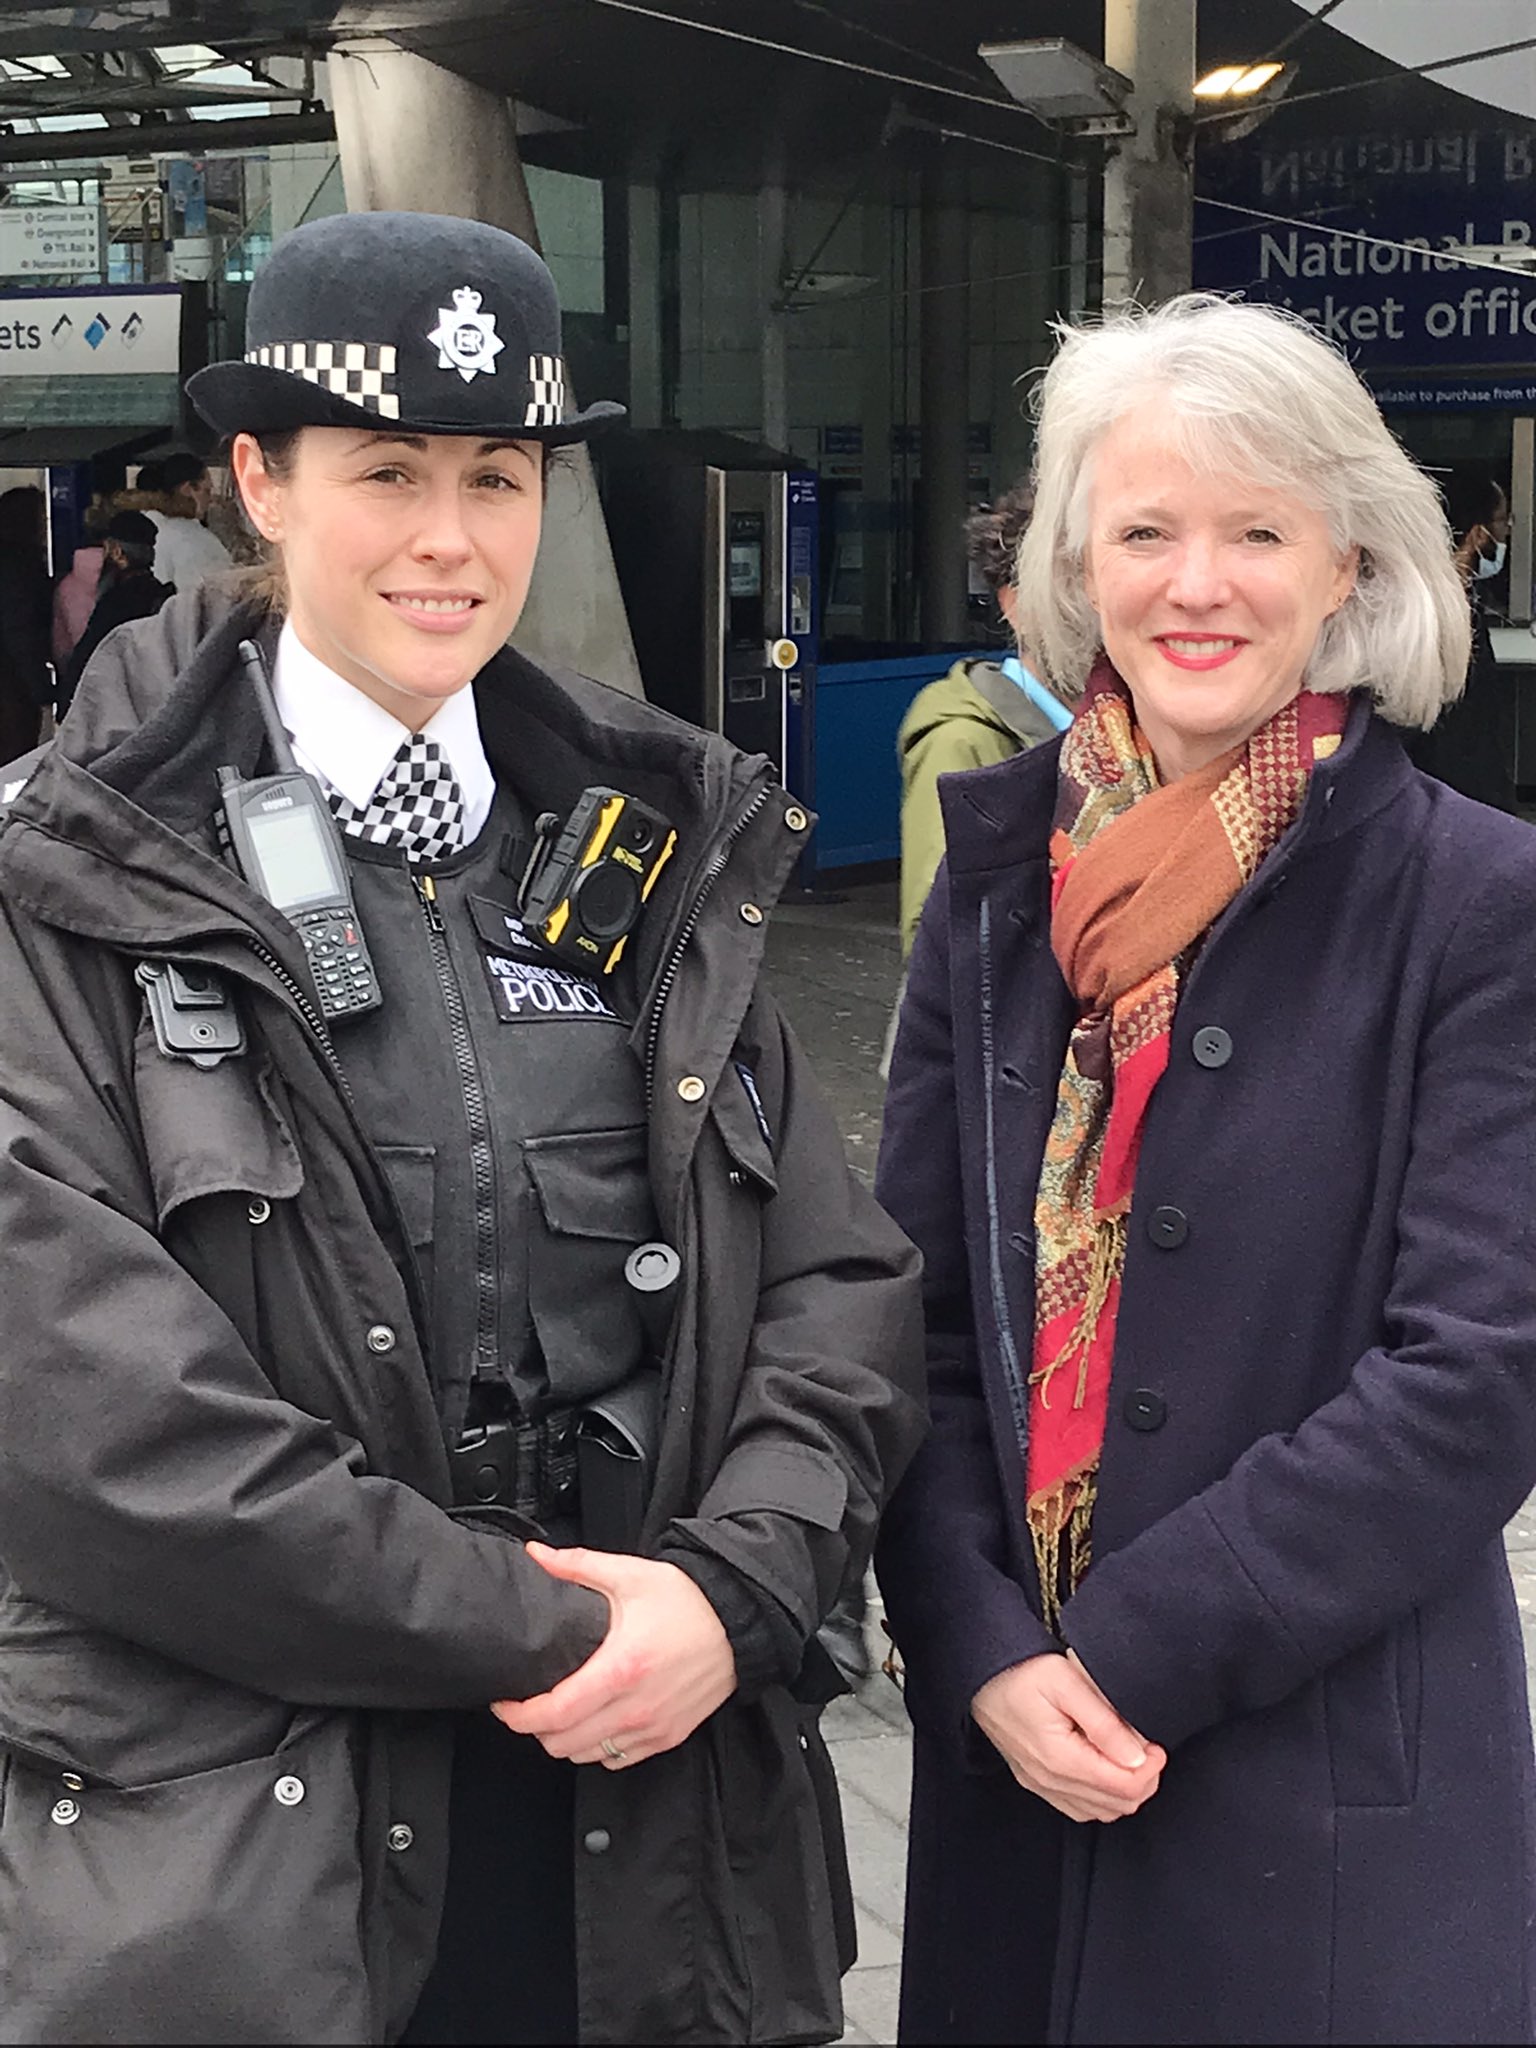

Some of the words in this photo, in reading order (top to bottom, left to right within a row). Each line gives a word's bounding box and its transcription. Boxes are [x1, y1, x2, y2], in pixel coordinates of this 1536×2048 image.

[1260, 220, 1479, 278] National
[0, 320, 41, 350] ets
[1419, 391, 1433, 402] to
[1436, 388, 1491, 405] purchase
[1493, 387, 1523, 400] from
